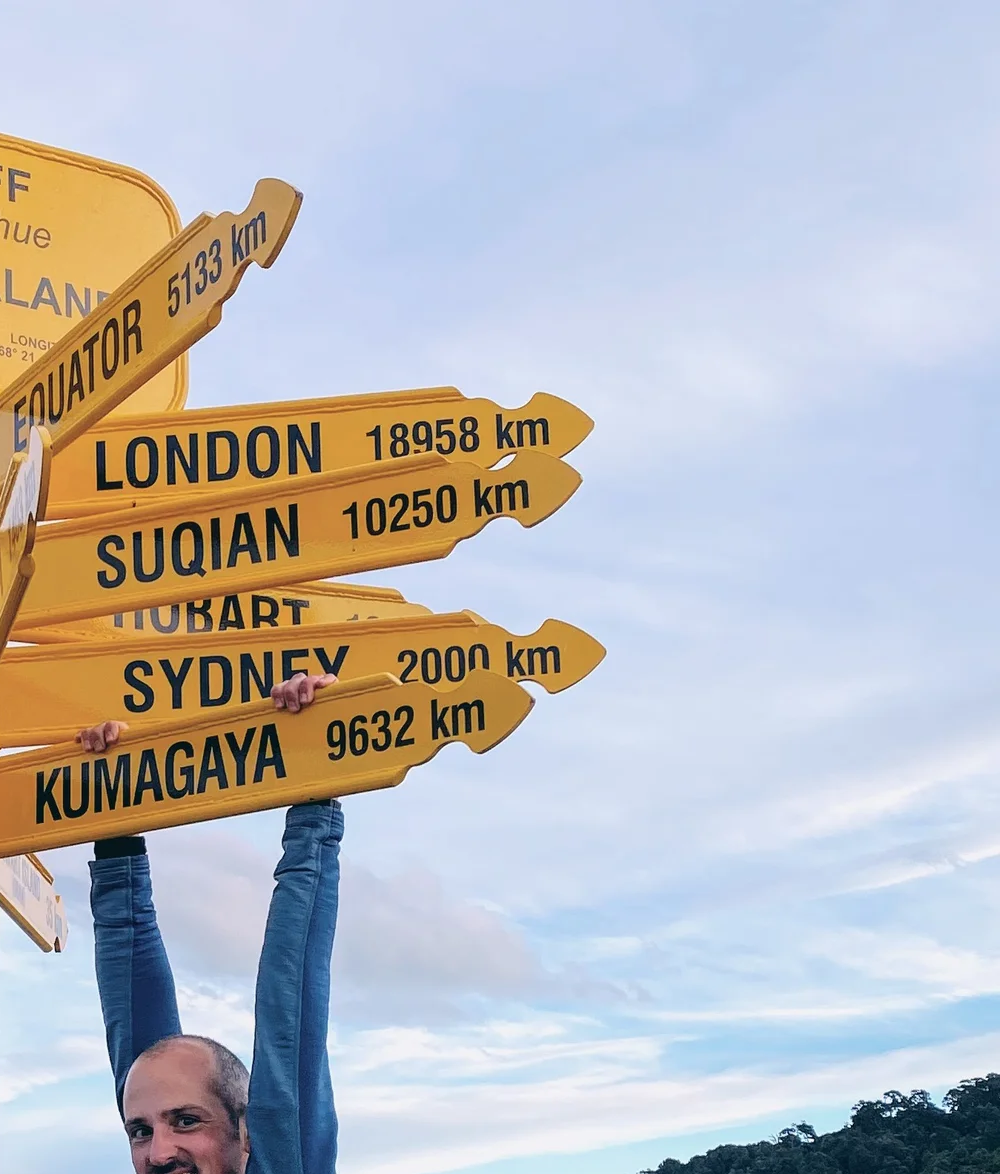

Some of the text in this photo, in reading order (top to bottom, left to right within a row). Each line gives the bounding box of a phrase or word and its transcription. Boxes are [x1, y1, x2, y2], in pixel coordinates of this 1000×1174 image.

[10, 332, 56, 351] LONGI
[13, 211, 266, 453] EQUATOR 5133 km
[21, 350, 34, 362] 21
[95, 413, 551, 492] LONDON 18958 km
[96, 477, 531, 590] SUQIAN 10250 km
[396, 643, 490, 684] 2000
[505, 640, 561, 679] km
[35, 698, 485, 824] KUMAGAYA 9632 km
